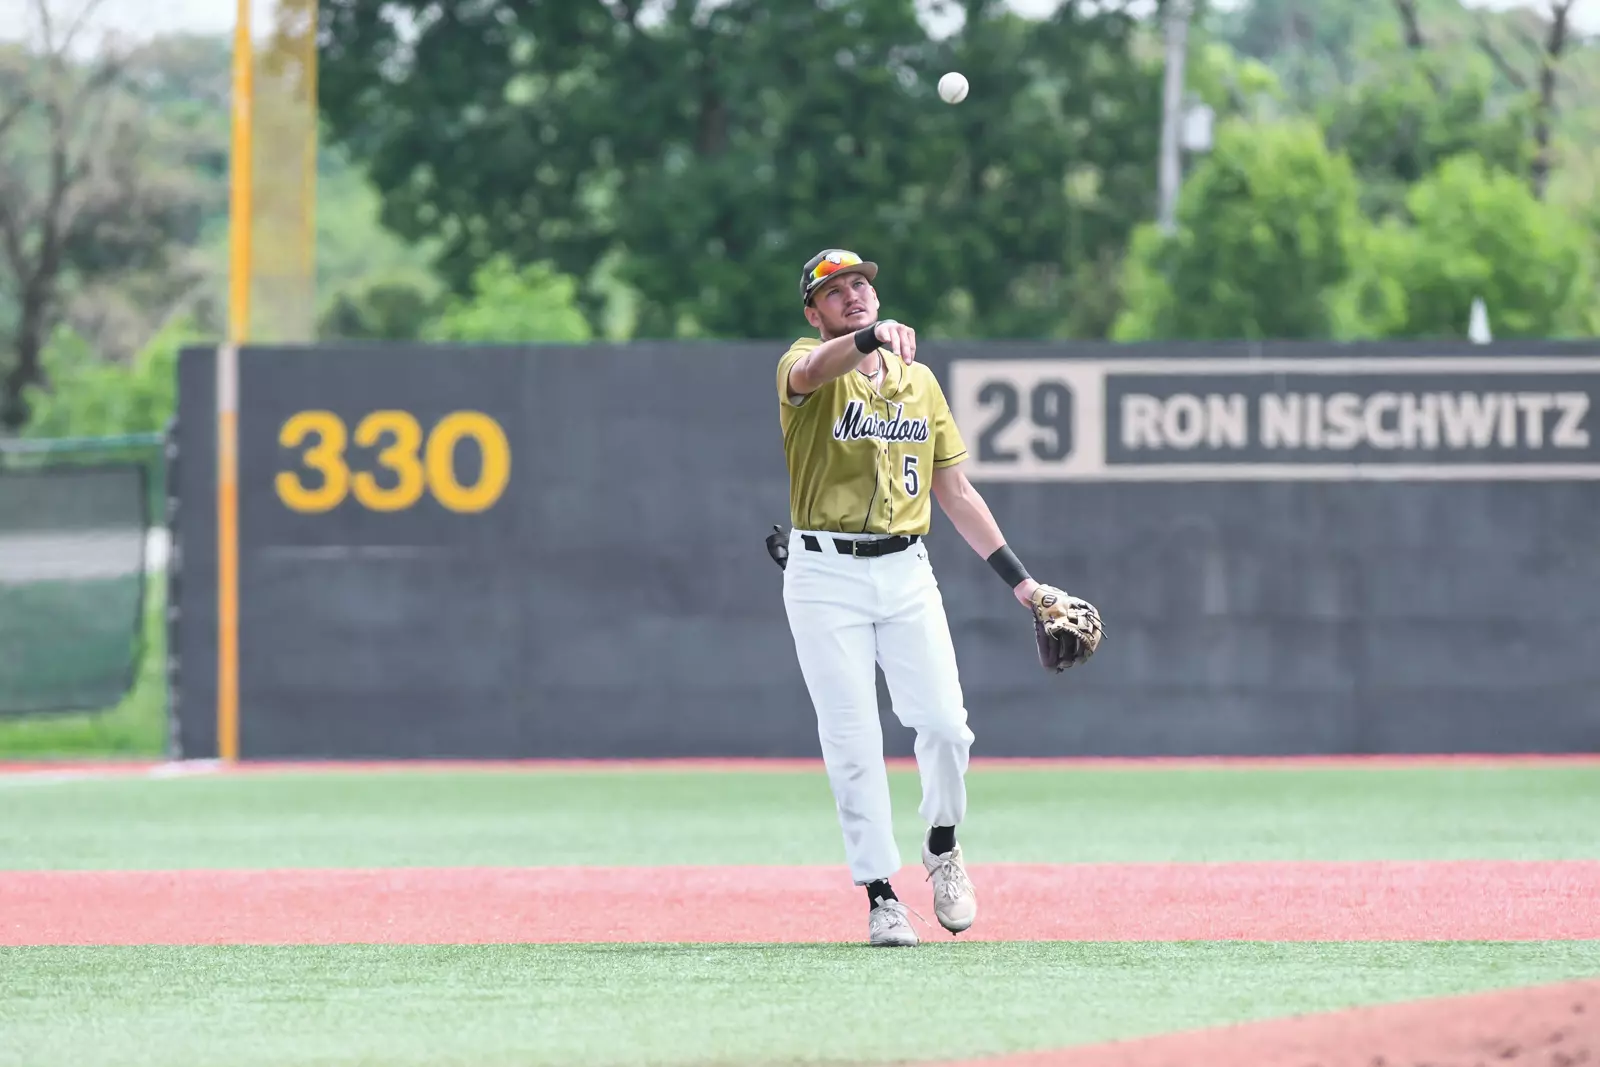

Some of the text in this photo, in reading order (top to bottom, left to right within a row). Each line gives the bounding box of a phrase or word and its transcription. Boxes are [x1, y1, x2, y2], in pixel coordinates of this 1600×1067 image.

[833, 400, 929, 443] Maodons
[976, 377, 1590, 463] 29 RON NISCHWITZ
[275, 410, 511, 513] 330
[903, 454, 919, 497] 5
